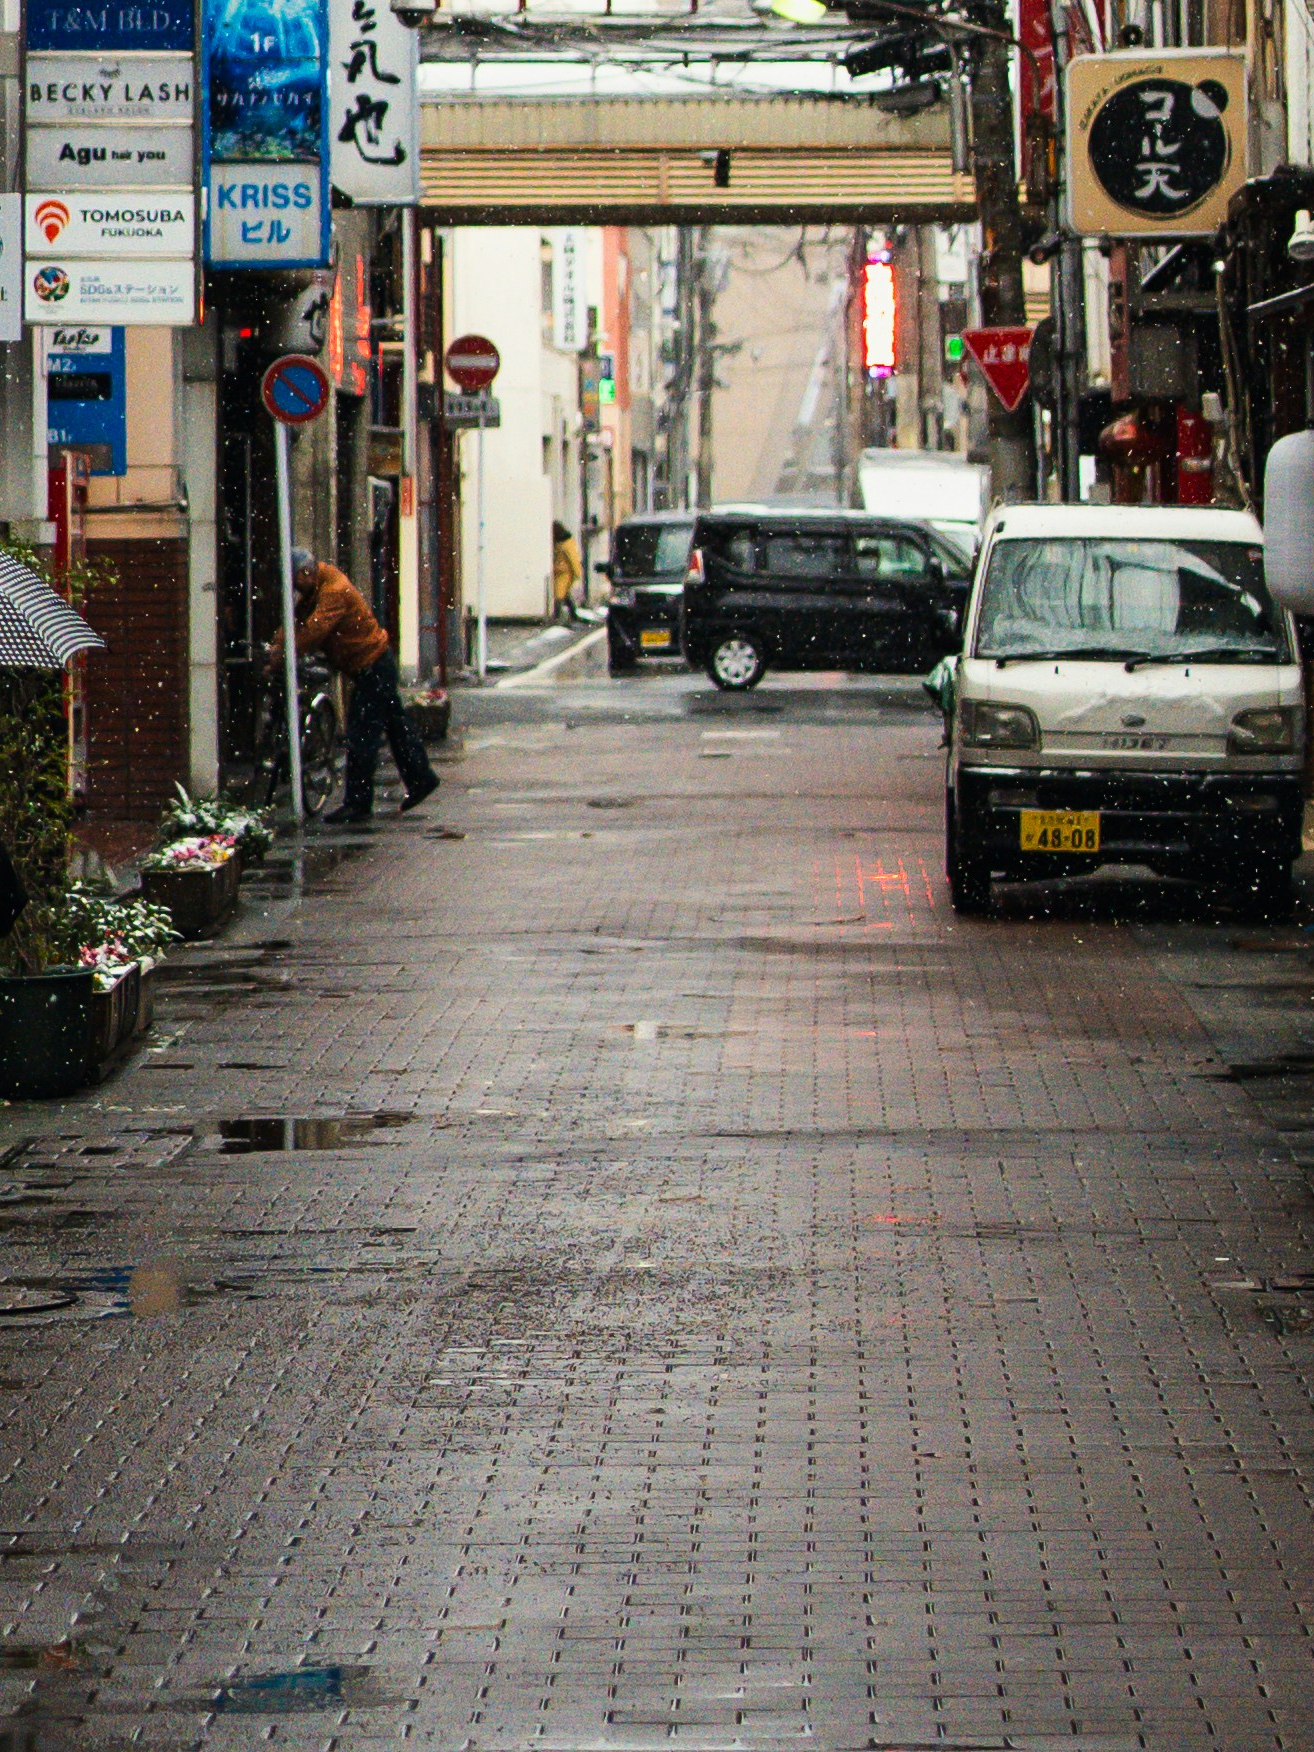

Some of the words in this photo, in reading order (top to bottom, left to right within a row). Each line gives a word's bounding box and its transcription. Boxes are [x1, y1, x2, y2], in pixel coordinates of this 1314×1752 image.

[45, 8, 107, 32] T&M
[250, 32, 278, 53] 1F
[29, 83, 113, 103] BECKY
[124, 83, 190, 103] LASH
[59, 142, 107, 166] Agu
[111, 149, 133, 161] hair
[137, 149, 166, 163] you
[216, 182, 314, 210] KRISS
[79, 209, 186, 223] TOMOSUBA
[101, 227, 163, 238] FUKUOKA
[240, 219, 292, 245] ビル
